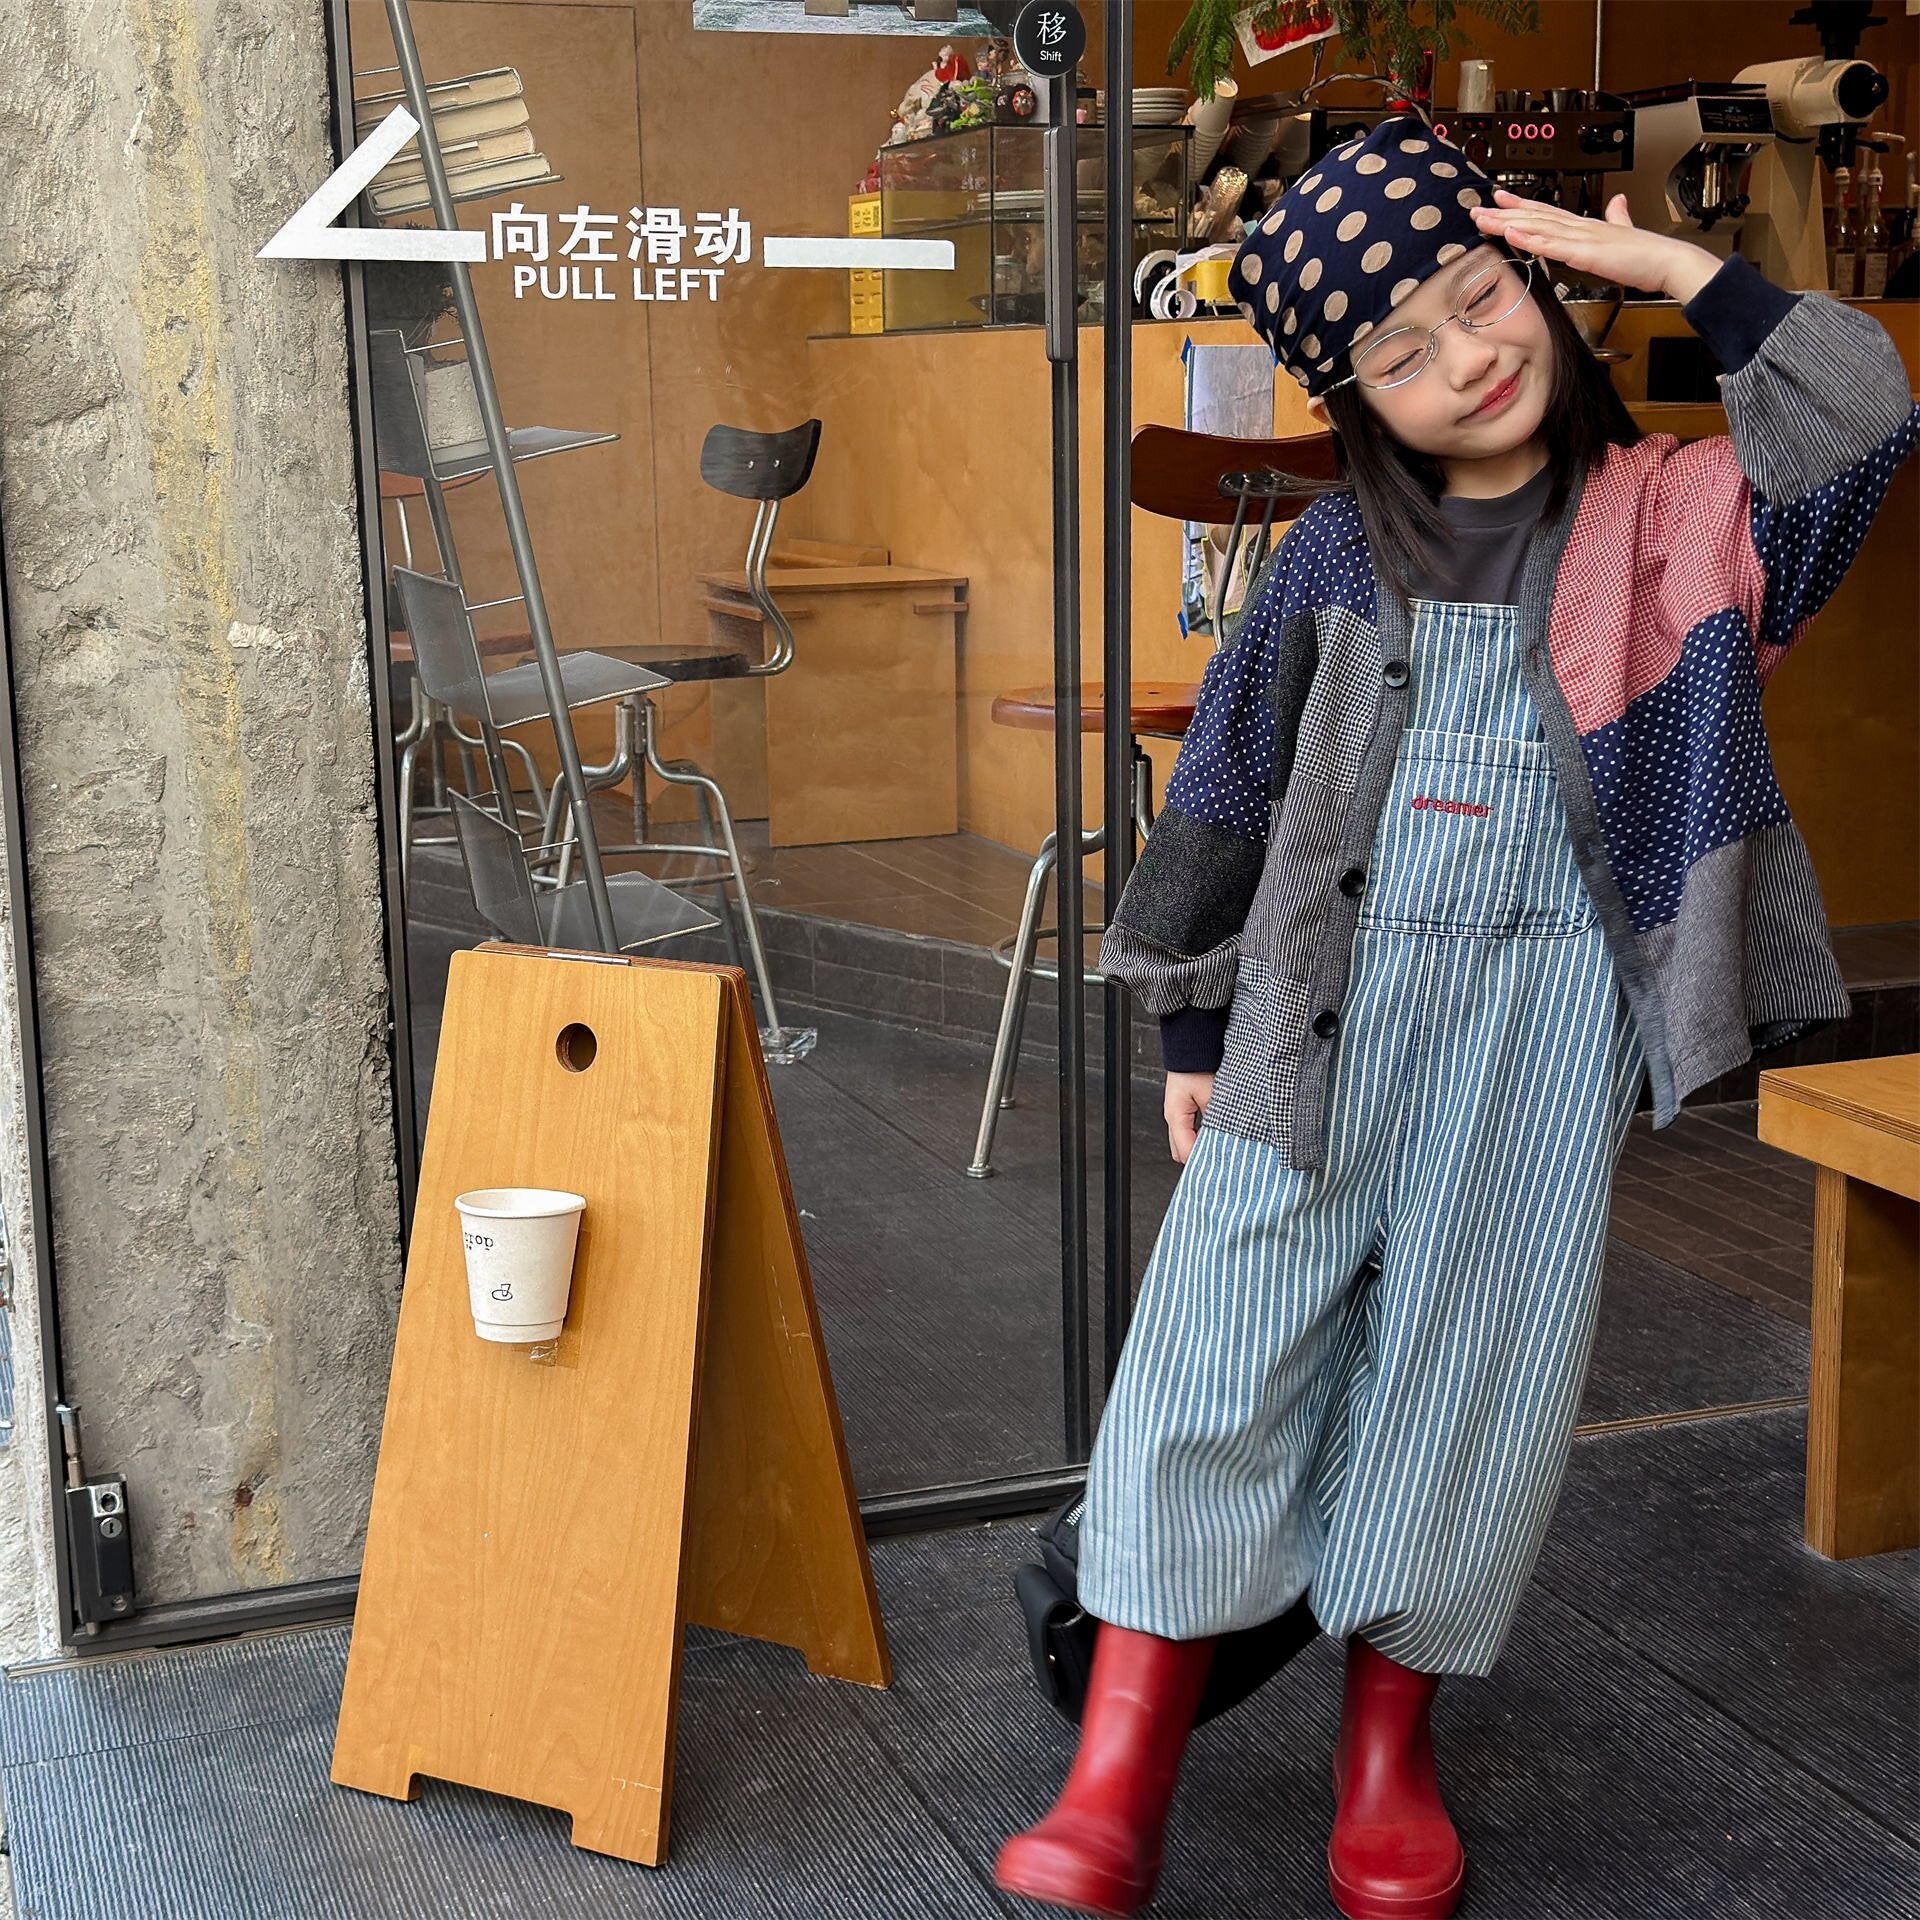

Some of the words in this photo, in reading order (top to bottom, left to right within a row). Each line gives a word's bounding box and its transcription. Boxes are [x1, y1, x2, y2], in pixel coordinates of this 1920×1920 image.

[1036, 11, 1067, 45] 移
[1040, 50, 1062, 62] Shift
[491, 202, 751, 265] 向左滑动
[513, 265, 616, 300] PULL
[633, 267, 725, 301] LEFT
[1411, 794, 1494, 819] dreamer
